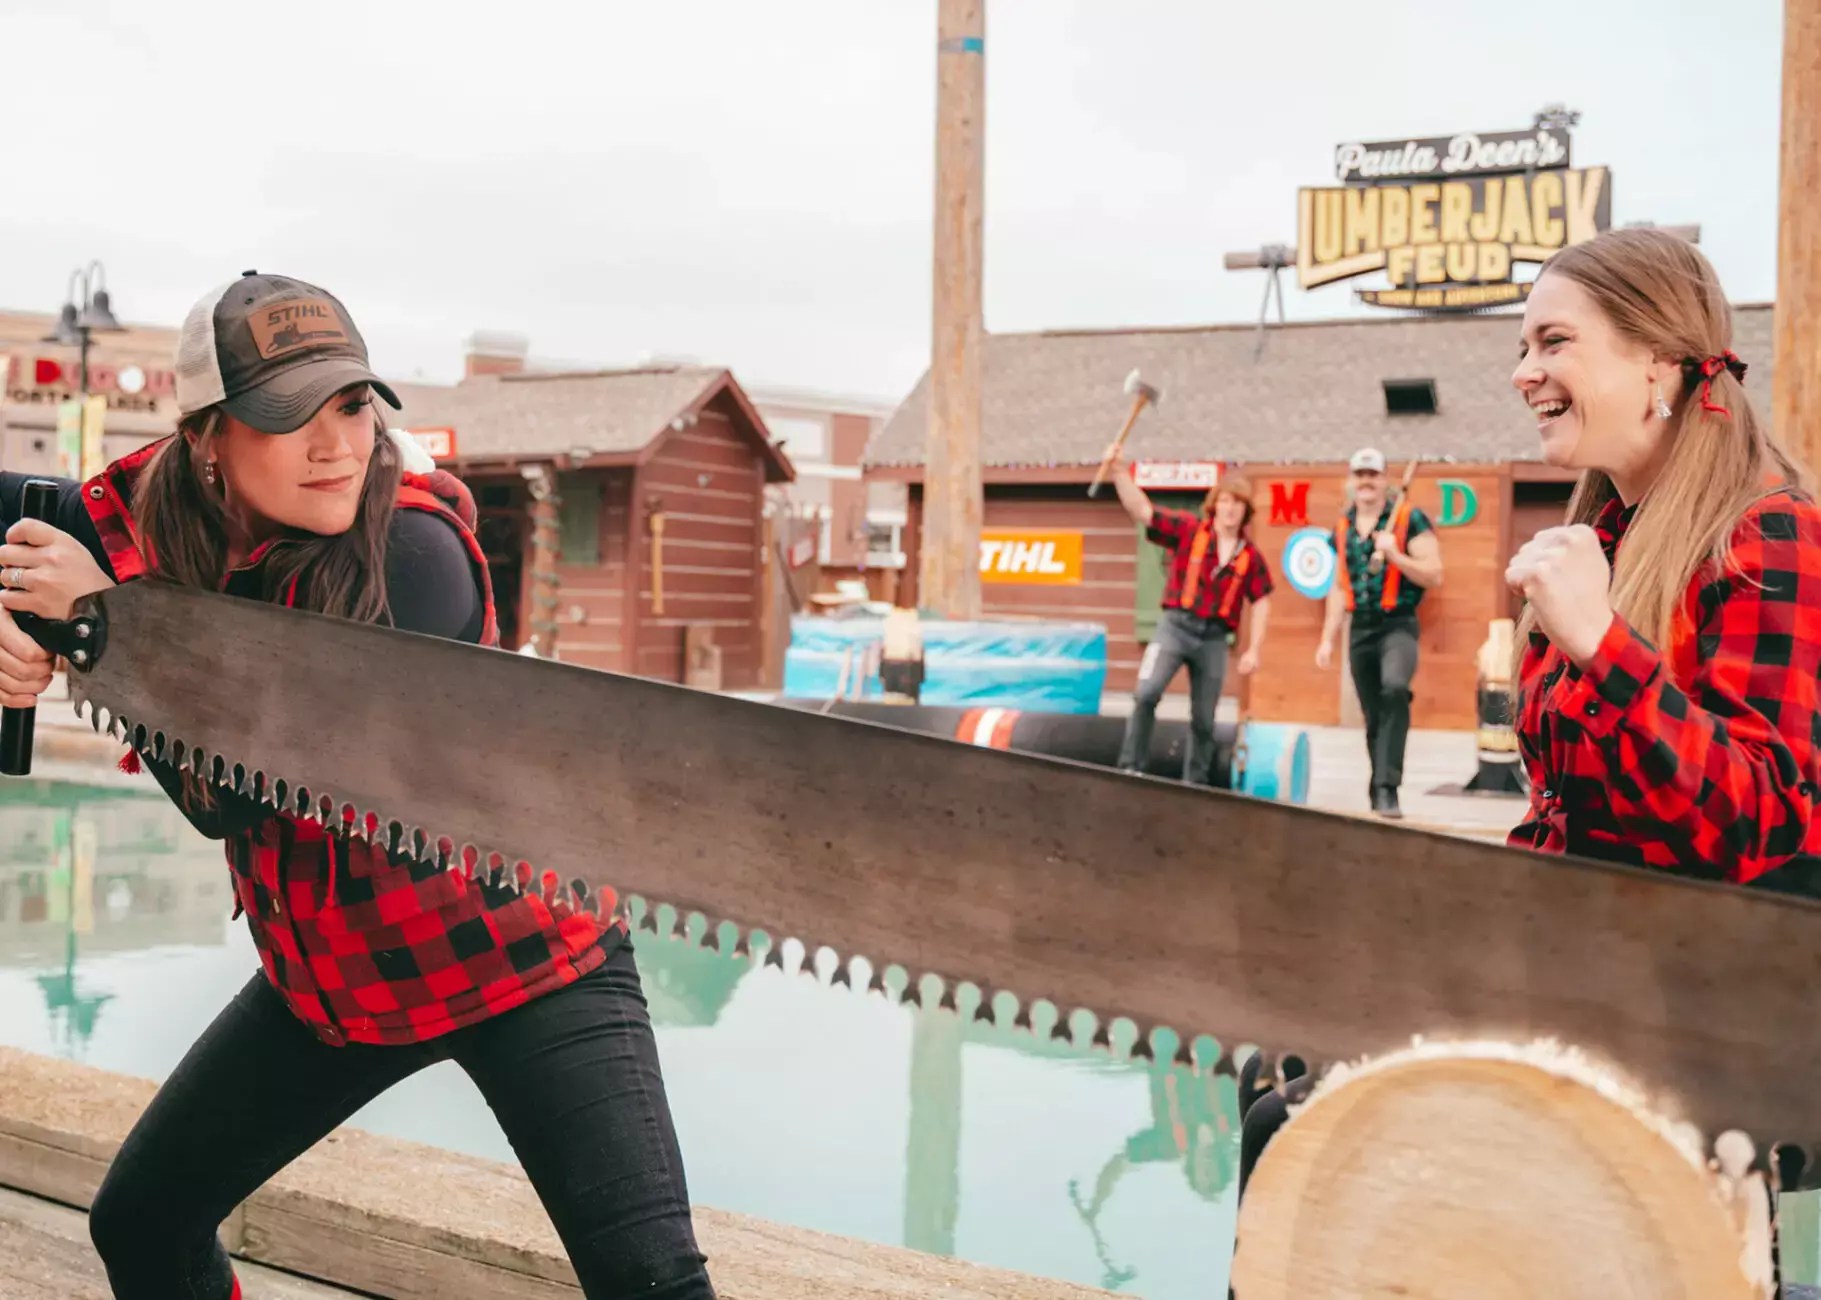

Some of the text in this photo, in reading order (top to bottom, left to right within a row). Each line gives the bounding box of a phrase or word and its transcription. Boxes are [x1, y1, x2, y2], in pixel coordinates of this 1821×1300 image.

[1336, 130, 1566, 179] Paula Deen's
[1299, 167, 1608, 288] LUMBERJACK
[1387, 242, 1510, 285] FEUD
[267, 304, 328, 328] STIHL
[1268, 482, 1312, 528] M
[1436, 478, 1479, 526] D
[979, 540, 1067, 573] TIHL
